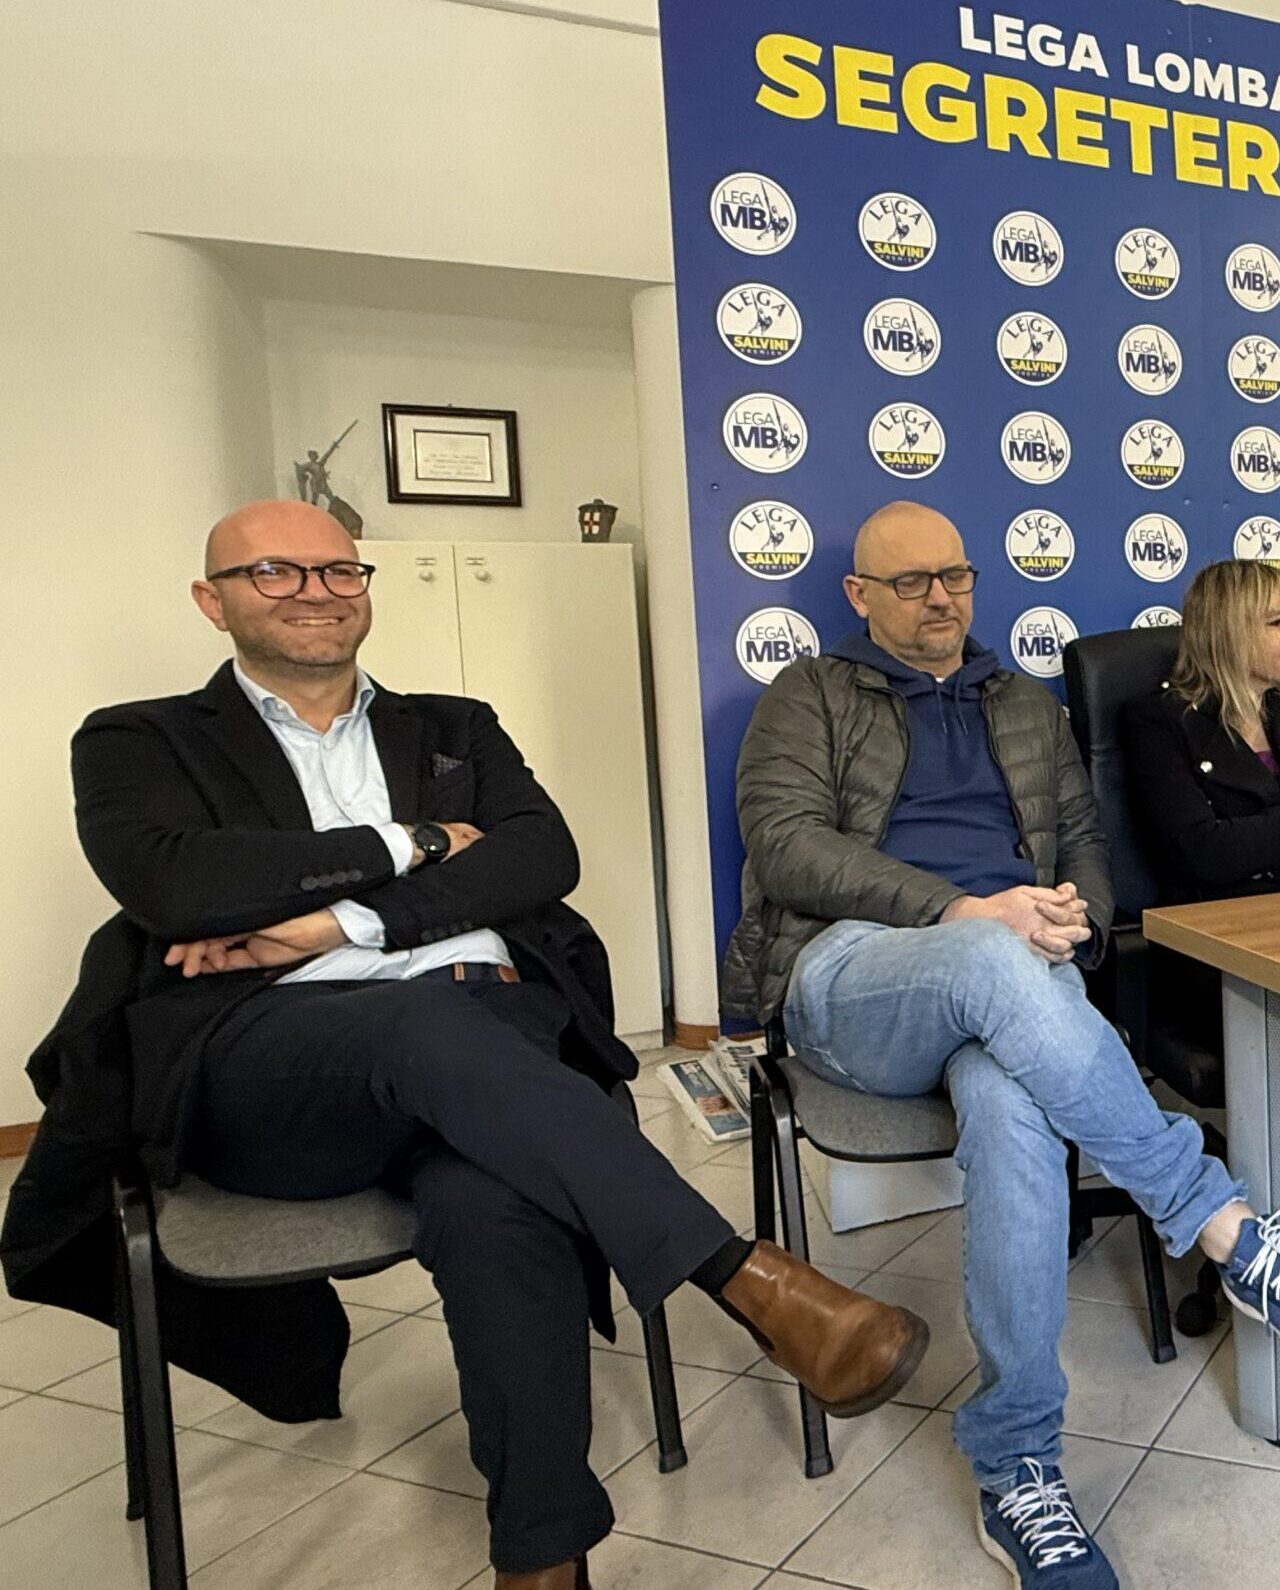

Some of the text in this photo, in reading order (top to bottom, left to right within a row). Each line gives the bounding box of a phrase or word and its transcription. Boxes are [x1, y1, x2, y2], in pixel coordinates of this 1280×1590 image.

[959, 6, 1109, 78] LEGA
[722, 189, 763, 208] LEGA
[720, 204, 768, 231] MB
[869, 200, 922, 226] LEGA
[1003, 227, 1036, 243] LEGA
[874, 243, 924, 258] SALVINI
[1001, 240, 1040, 264] MB
[1124, 235, 1168, 259] LEGA
[1128, 274, 1169, 288] SALVINI
[1232, 270, 1265, 292] MB
[728, 291, 786, 318] LEGA
[874, 315, 911, 331] LEGA
[1006, 319, 1054, 343] LEGA
[734, 336, 788, 351] SALVINI
[872, 328, 915, 353] MB
[1127, 340, 1157, 354] LEGA
[1236, 342, 1277, 363] LEGA
[1011, 360, 1056, 373] SALVINI
[1125, 352, 1160, 374] MB
[1240, 379, 1277, 391] SALVINI
[734, 411, 775, 426] LEGA
[879, 409, 931, 434] LEGA
[732, 425, 779, 449] MB
[1011, 428, 1044, 441] LEGA
[1129, 426, 1173, 448] LEGA
[884, 453, 933, 465] SALVINI
[1009, 441, 1047, 462] MB
[1133, 466, 1174, 476] SALVINI
[1237, 453, 1269, 473] MB
[740, 508, 798, 532] LEGA
[1015, 516, 1062, 538] LEGA
[1133, 530, 1164, 541] LEGA
[746, 554, 800, 564] SALVINI
[1132, 542, 1166, 561] MB
[1019, 558, 1063, 567] SALVINI
[747, 628, 787, 641] LEGA
[1019, 625, 1052, 636] LEGA
[745, 642, 791, 663] MB
[1018, 637, 1056, 657] MB
